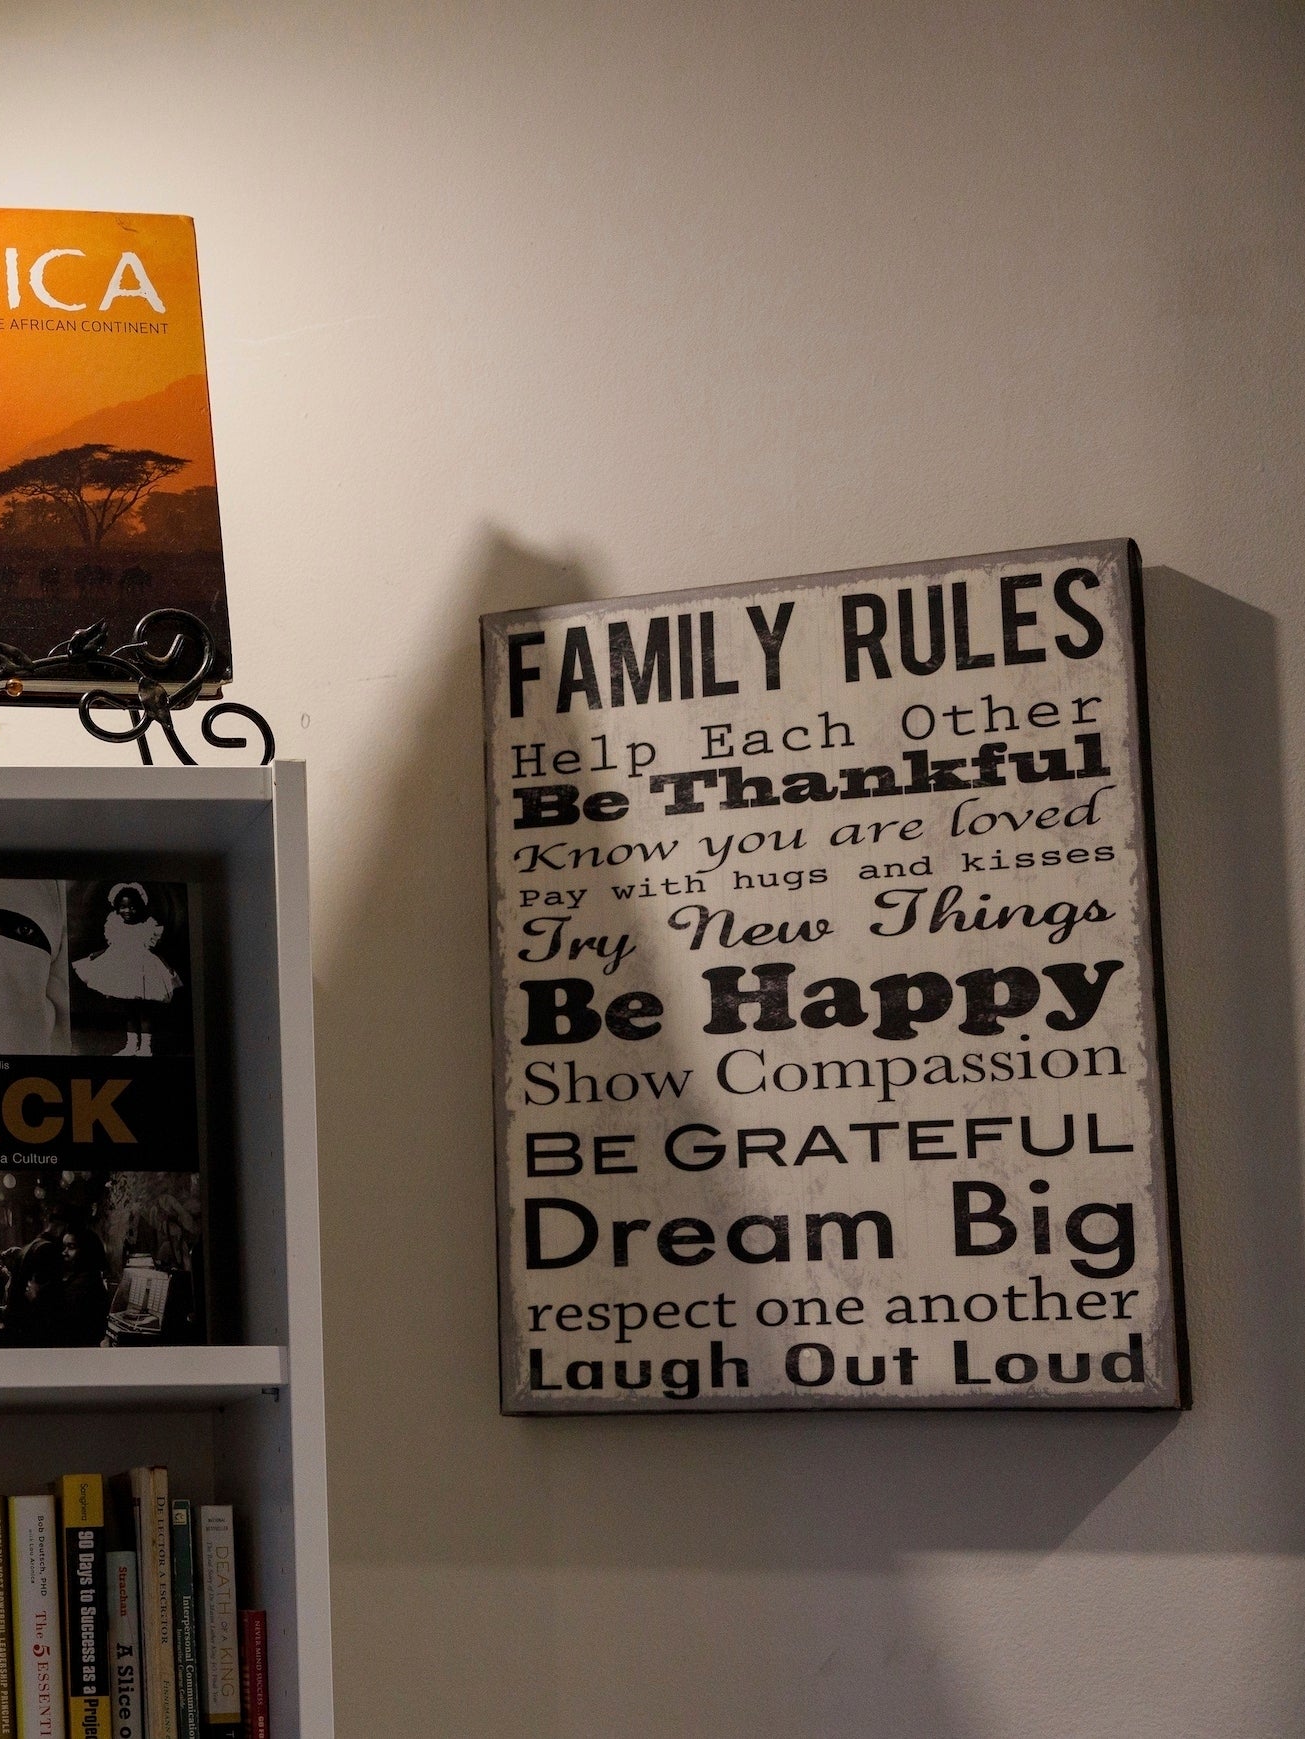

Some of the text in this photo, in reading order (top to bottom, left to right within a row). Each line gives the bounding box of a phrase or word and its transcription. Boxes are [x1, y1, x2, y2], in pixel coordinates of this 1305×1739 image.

[10, 317, 77, 332] AFRICAN
[80, 319, 169, 335] CONTINENT
[508, 567, 1105, 717] FAMILY RULES
[511, 695, 1102, 777] Help Each Other
[513, 732, 1111, 829] Be Thankful
[514, 786, 1117, 873] Know you are loved
[612, 874, 706, 901] with
[734, 867, 828, 892] hugs
[858, 855, 932, 880] and
[961, 844, 1114, 872] kisses
[517, 885, 1115, 976] Try New Things
[519, 959, 1125, 1046] Be Happy
[523, 1033, 1126, 1106] Show Compassion
[0, 1155, 8, 1164] a
[12, 1153, 58, 1164] Culture
[525, 1113, 1134, 1178] BE GRATEFUL
[523, 1179, 1135, 1279] Dream Big
[527, 1275, 1139, 1344] respect one another
[529, 1333, 1145, 1401] Laugh Out Loud
[78, 1483, 89, 1520] Sanghera
[77, 1530, 96, 1694] 90 Days to Success as a
[118, 1566, 128, 1616] Strachan
[0, 1690, 10, 1733] PRINCIPLE
